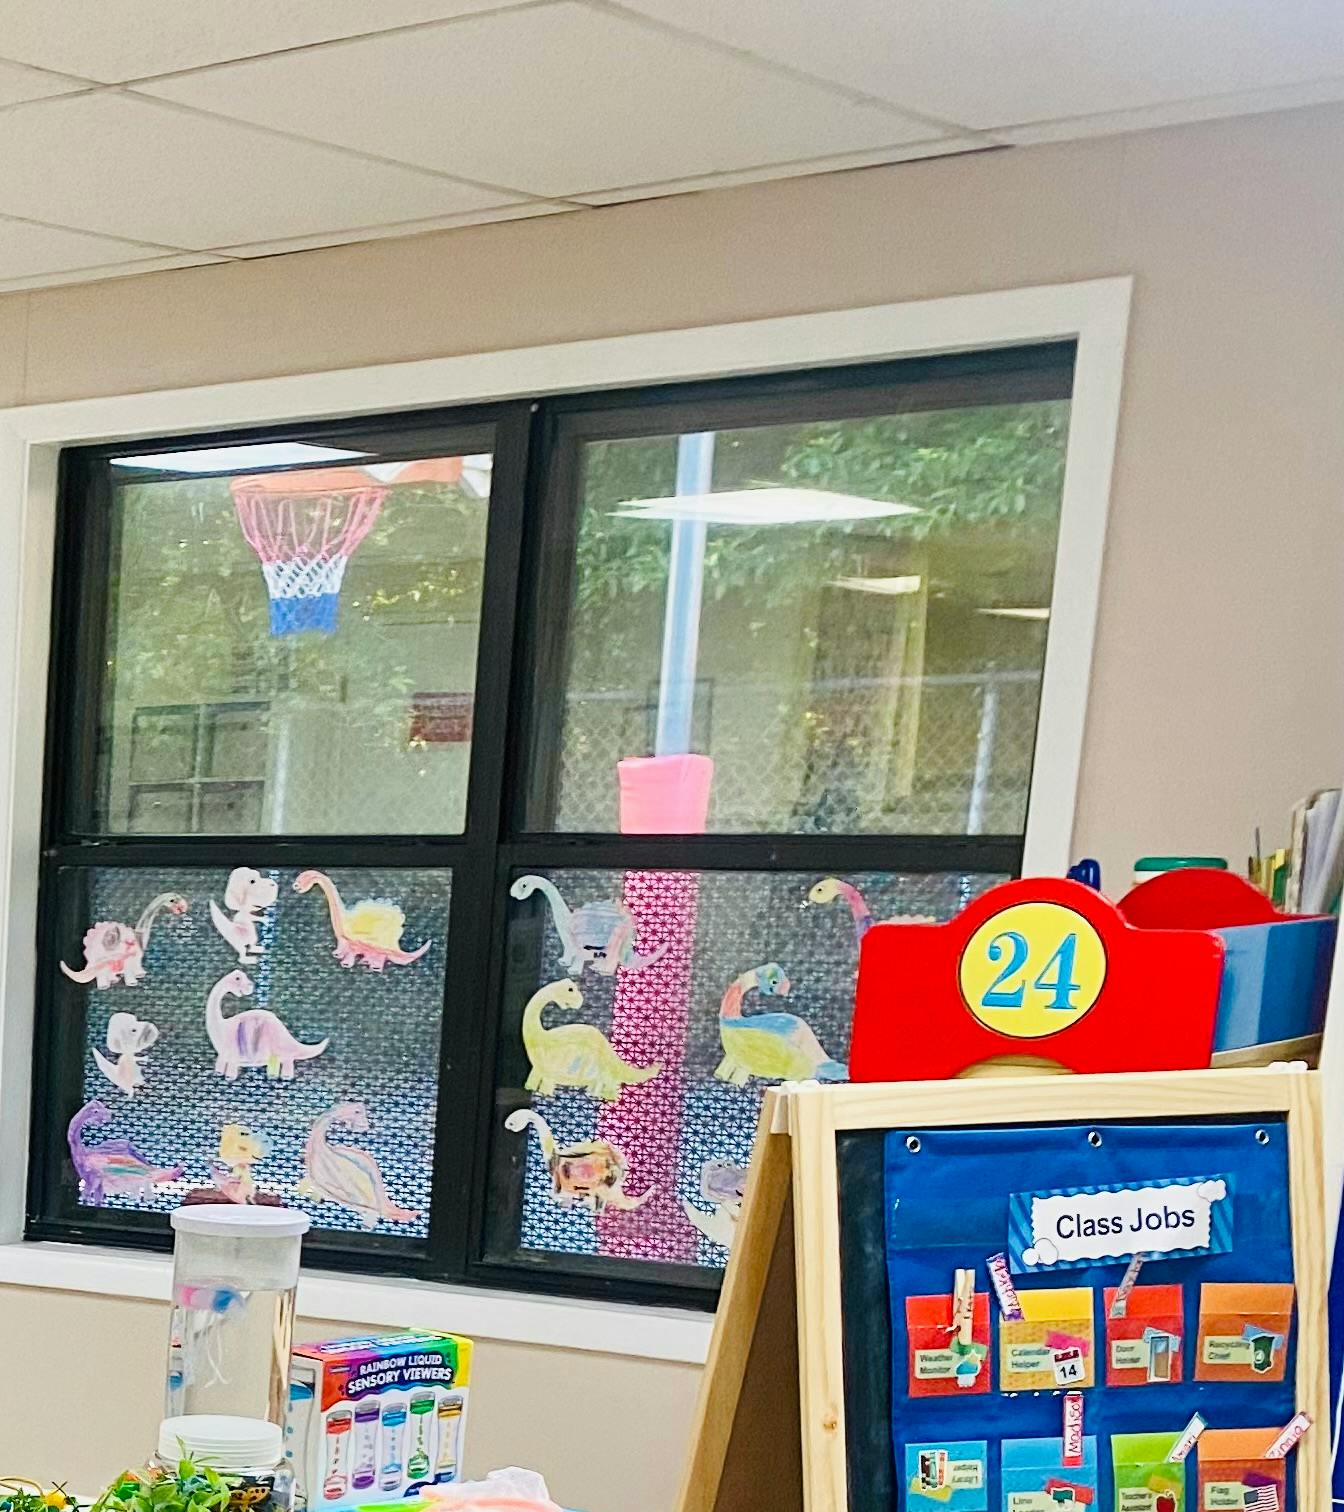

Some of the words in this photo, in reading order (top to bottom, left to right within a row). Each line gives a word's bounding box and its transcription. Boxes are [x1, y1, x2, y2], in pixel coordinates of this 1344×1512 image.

[981, 931, 1081, 1010] 24
[1056, 1213, 1123, 1239] Class
[1129, 1205, 1196, 1232] Jobs
[359, 1356, 407, 1376] RAINBOW
[408, 1354, 443, 1366] LIQUID
[1059, 1363, 1078, 1380] 14
[347, 1369, 401, 1394] SENSORY
[402, 1367, 453, 1381] VIEWERS
